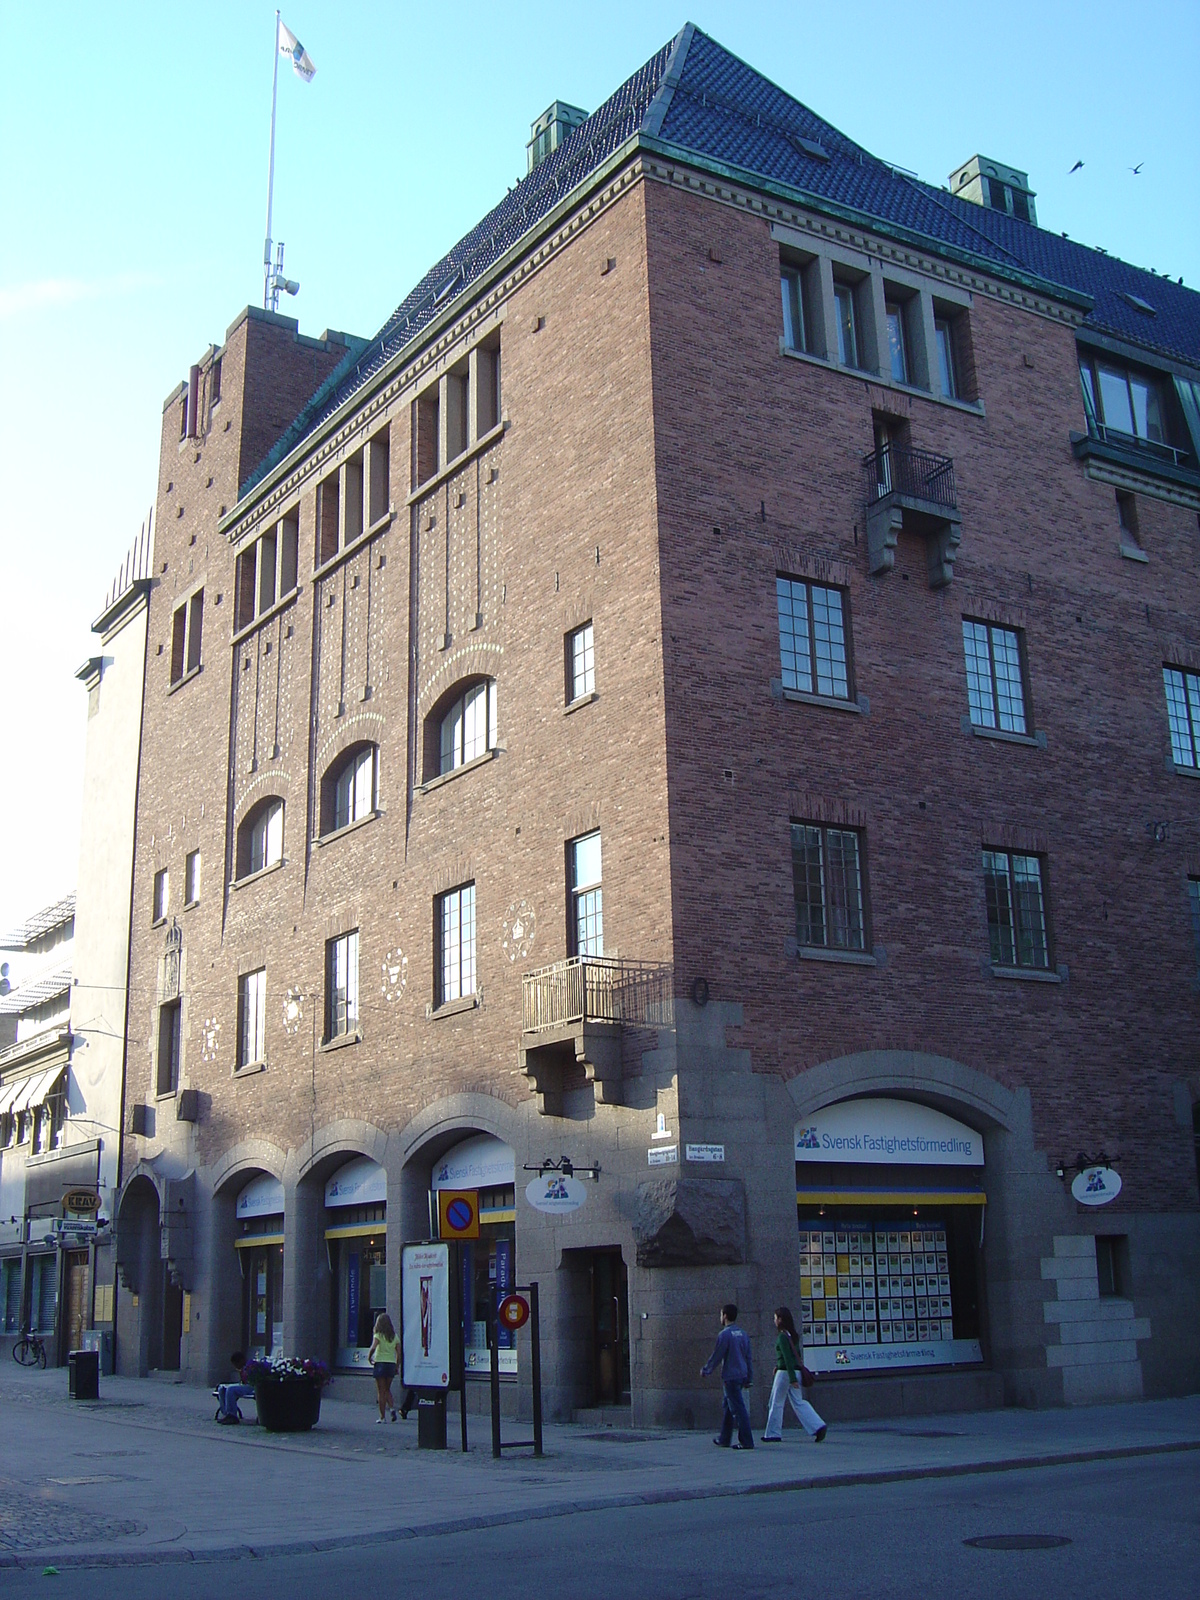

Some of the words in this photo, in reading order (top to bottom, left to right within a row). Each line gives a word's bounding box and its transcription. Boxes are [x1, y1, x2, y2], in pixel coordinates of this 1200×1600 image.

[822, 1133, 862, 1149] Svensk
[864, 1134, 972, 1155] Fastighetsförmedling
[68, 1196, 97, 1206] KRAV
[850, 1351, 871, 1361] Svensk
